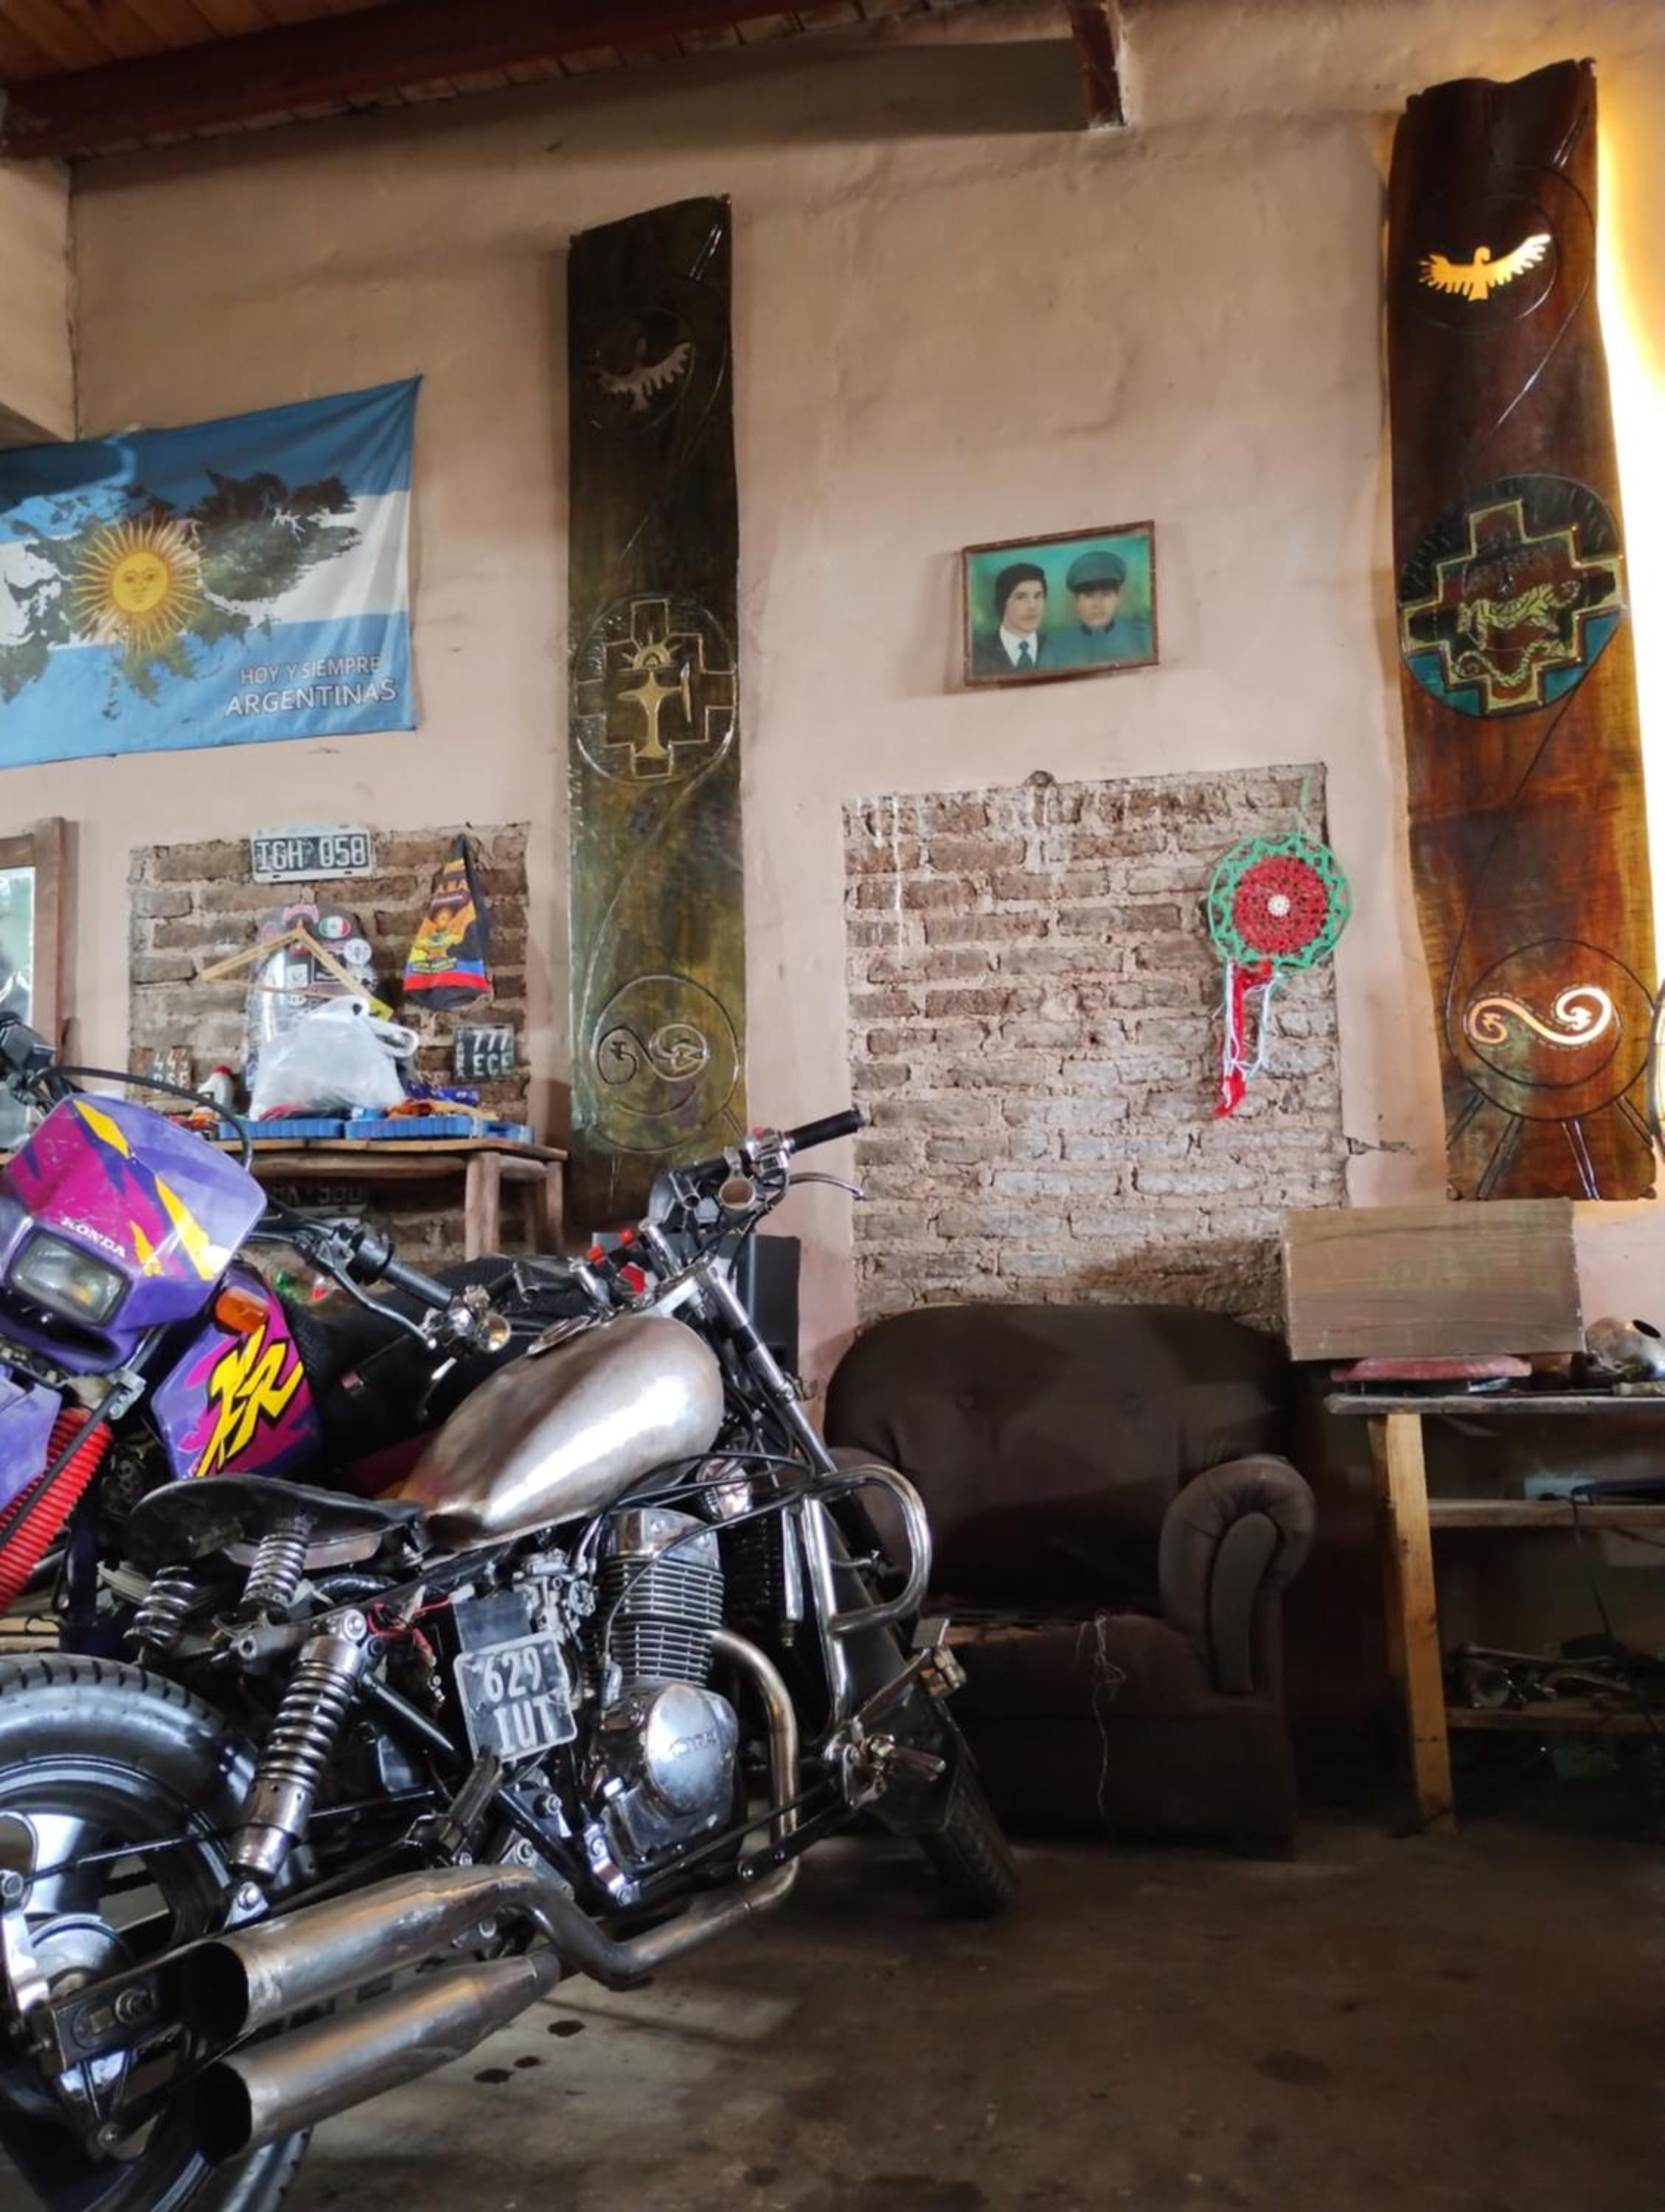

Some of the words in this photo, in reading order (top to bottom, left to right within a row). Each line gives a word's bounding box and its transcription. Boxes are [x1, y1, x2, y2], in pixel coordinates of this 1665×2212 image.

[240, 665, 279, 685] HOY
[287, 664, 298, 680] Y
[302, 655, 381, 679] SIEMPRE
[226, 678, 397, 716] ARGENTINAS
[319, 835, 366, 869] 058
[472, 1029, 510, 1051] 777
[473, 1052, 512, 1077] ECE
[484, 1646, 543, 1703] 629
[493, 1694, 557, 1754] IUT
